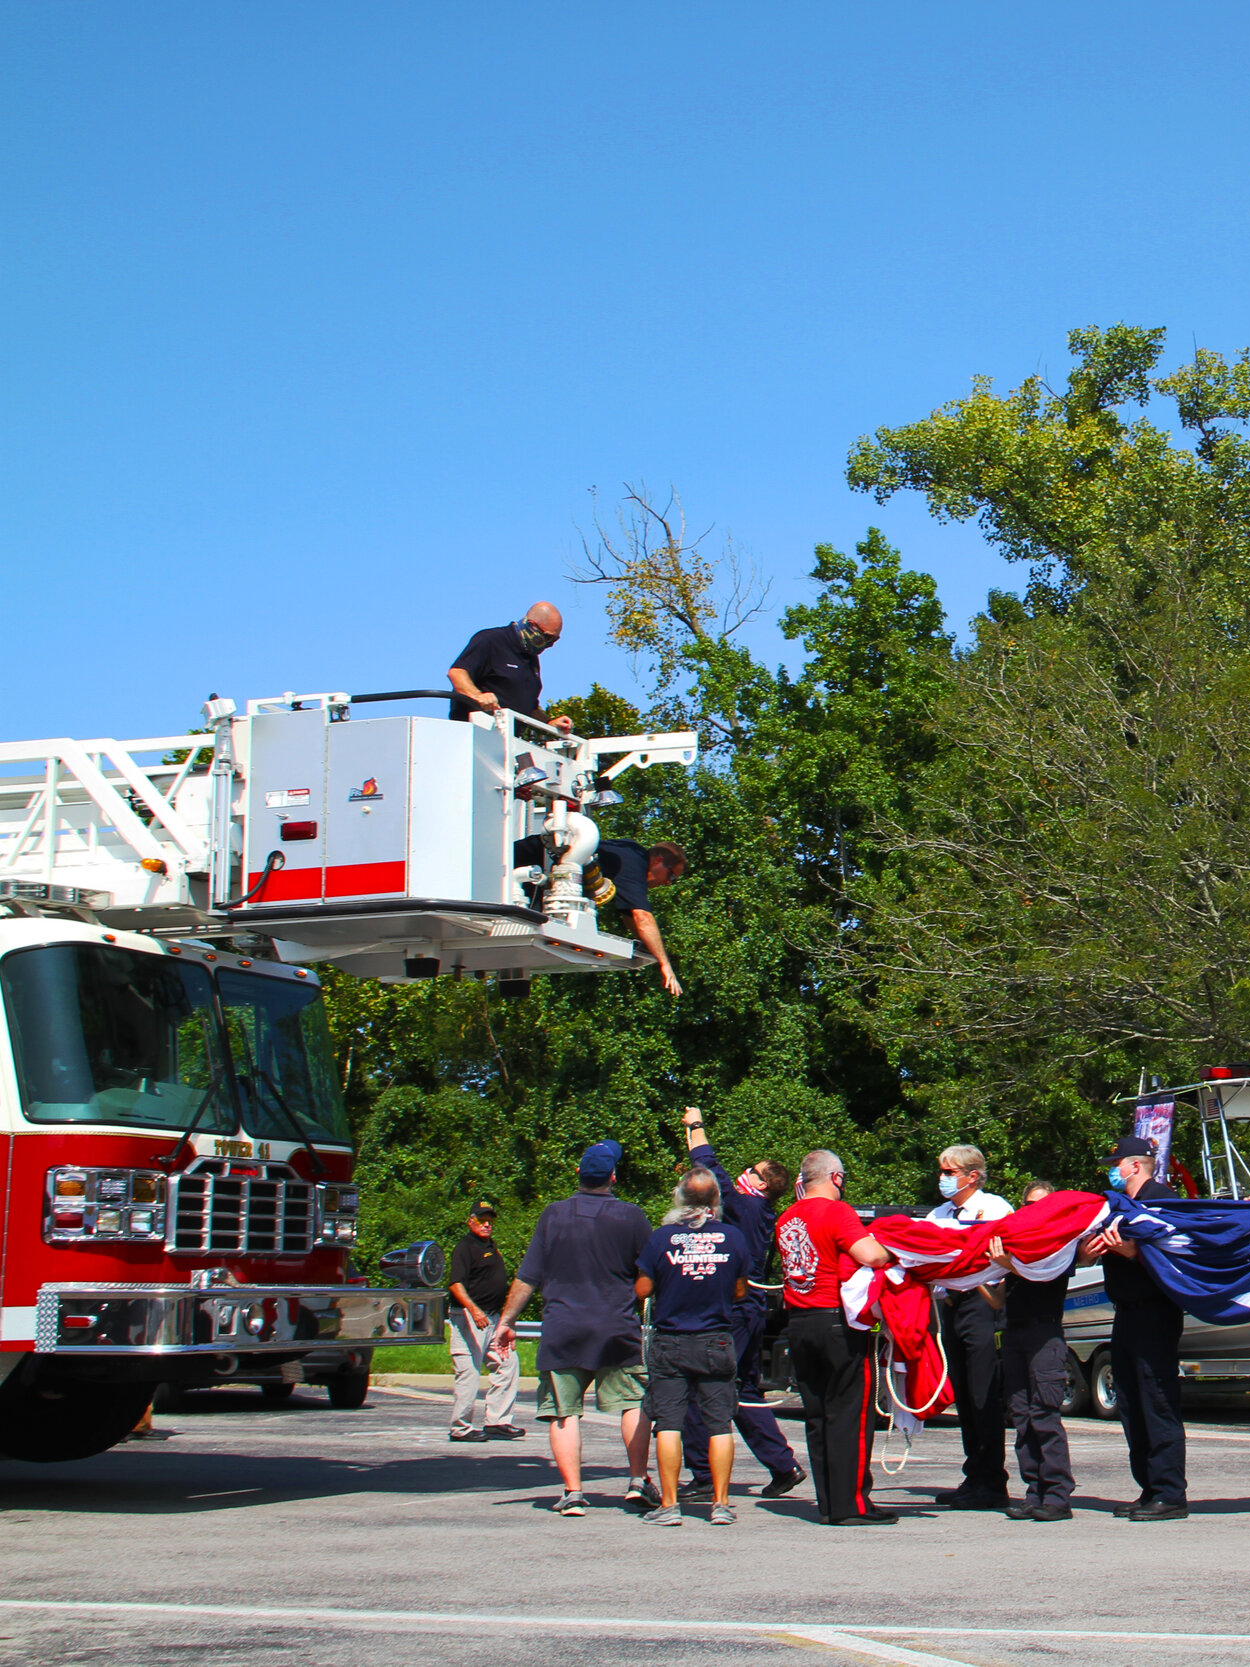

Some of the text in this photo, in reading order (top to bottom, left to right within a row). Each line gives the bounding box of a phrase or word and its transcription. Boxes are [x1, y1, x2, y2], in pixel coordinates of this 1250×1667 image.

[215, 1139, 253, 1157] TOWER
[670, 1232, 726, 1246] GROUND
[682, 1242, 716, 1254] ZERO
[682, 1262, 717, 1276] FLAG
[1073, 1293, 1099, 1307] METRO
